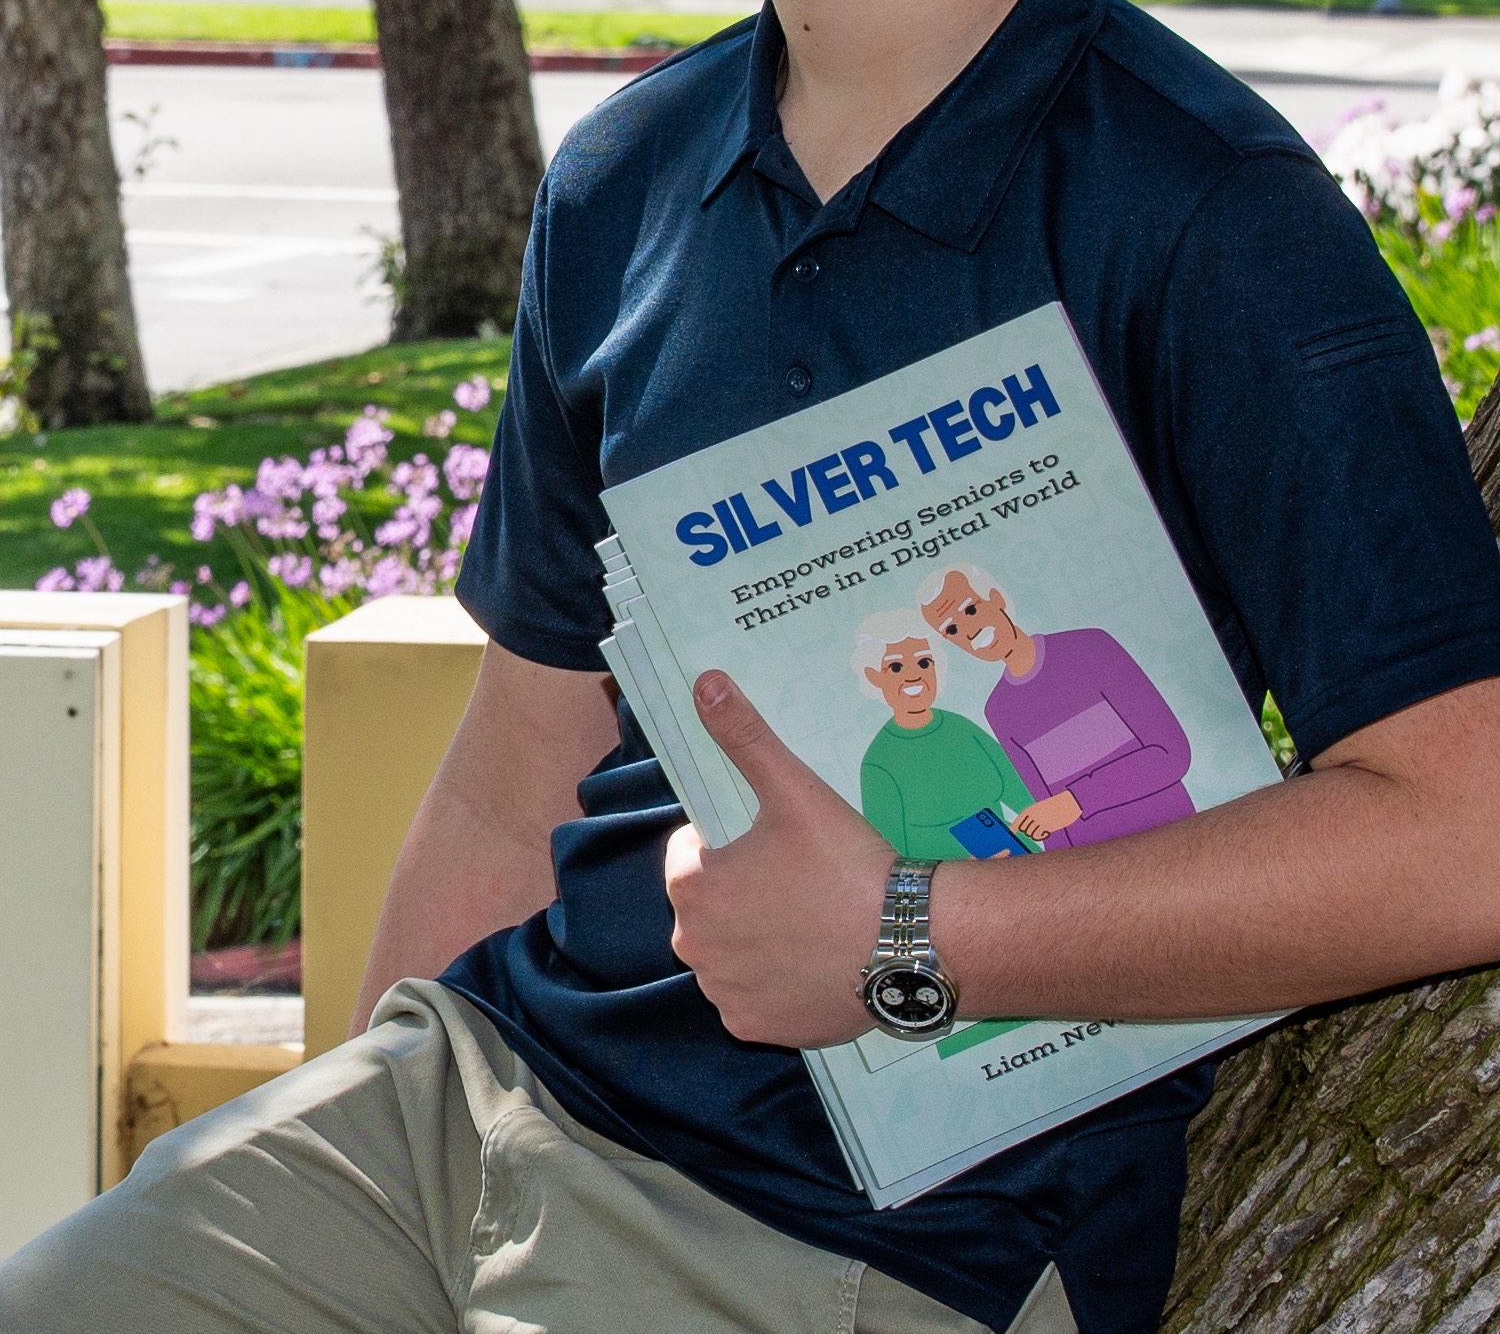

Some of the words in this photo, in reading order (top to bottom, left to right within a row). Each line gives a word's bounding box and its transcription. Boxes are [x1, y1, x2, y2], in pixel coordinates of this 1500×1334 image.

[675, 440, 900, 567] SILVER
[888, 363, 1062, 475] TECH
[730, 519, 914, 605] Empowering
[917, 469, 1026, 527] Seniors
[1029, 454, 1060, 474] to
[735, 584, 832, 631] Thrive
[834, 570, 867, 591] in
[869, 559, 890, 576] a
[891, 512, 992, 567] Digital
[990, 470, 1081, 519] World
[981, 1041, 1060, 1081] Liam
